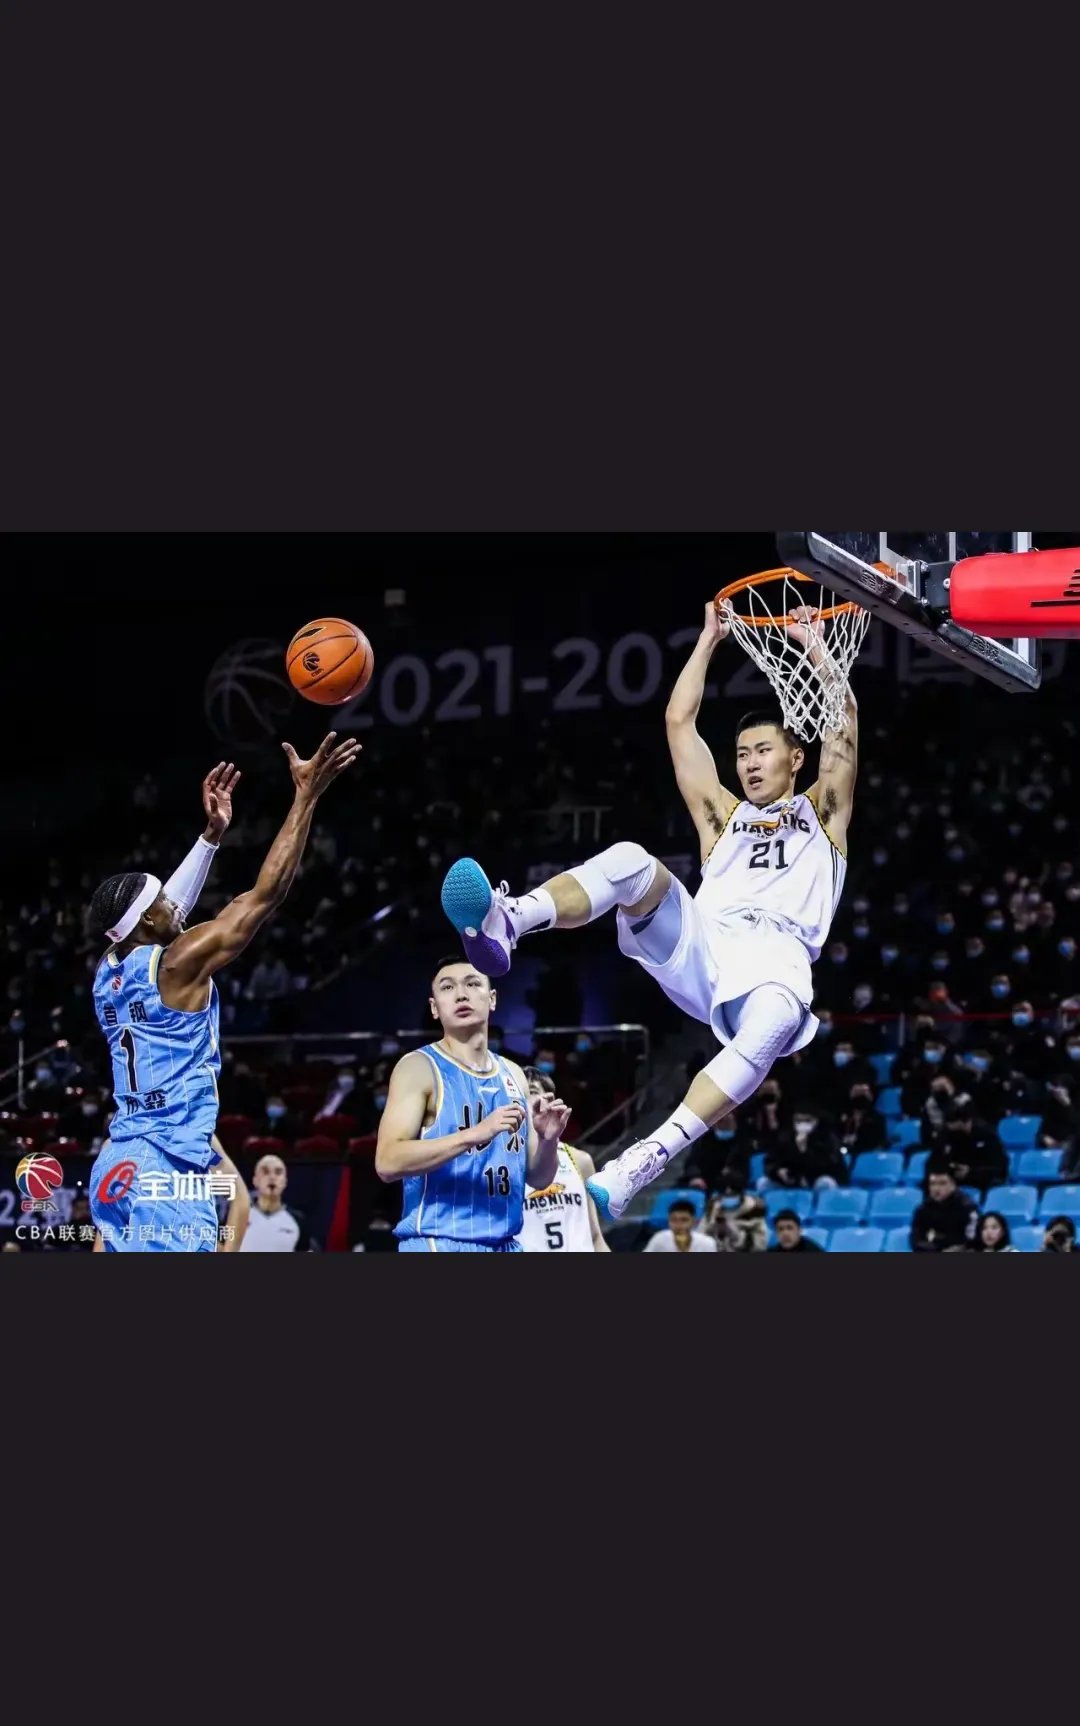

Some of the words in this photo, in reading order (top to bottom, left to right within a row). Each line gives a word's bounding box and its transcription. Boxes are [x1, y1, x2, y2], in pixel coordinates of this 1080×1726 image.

[733, 812, 810, 834] LIAOING
[749, 840, 789, 869] 21
[120, 1027, 139, 1093] 1
[484, 1166, 511, 1197] 13
[523, 1193, 582, 1211] IAONING
[545, 1221, 564, 1250] 5
